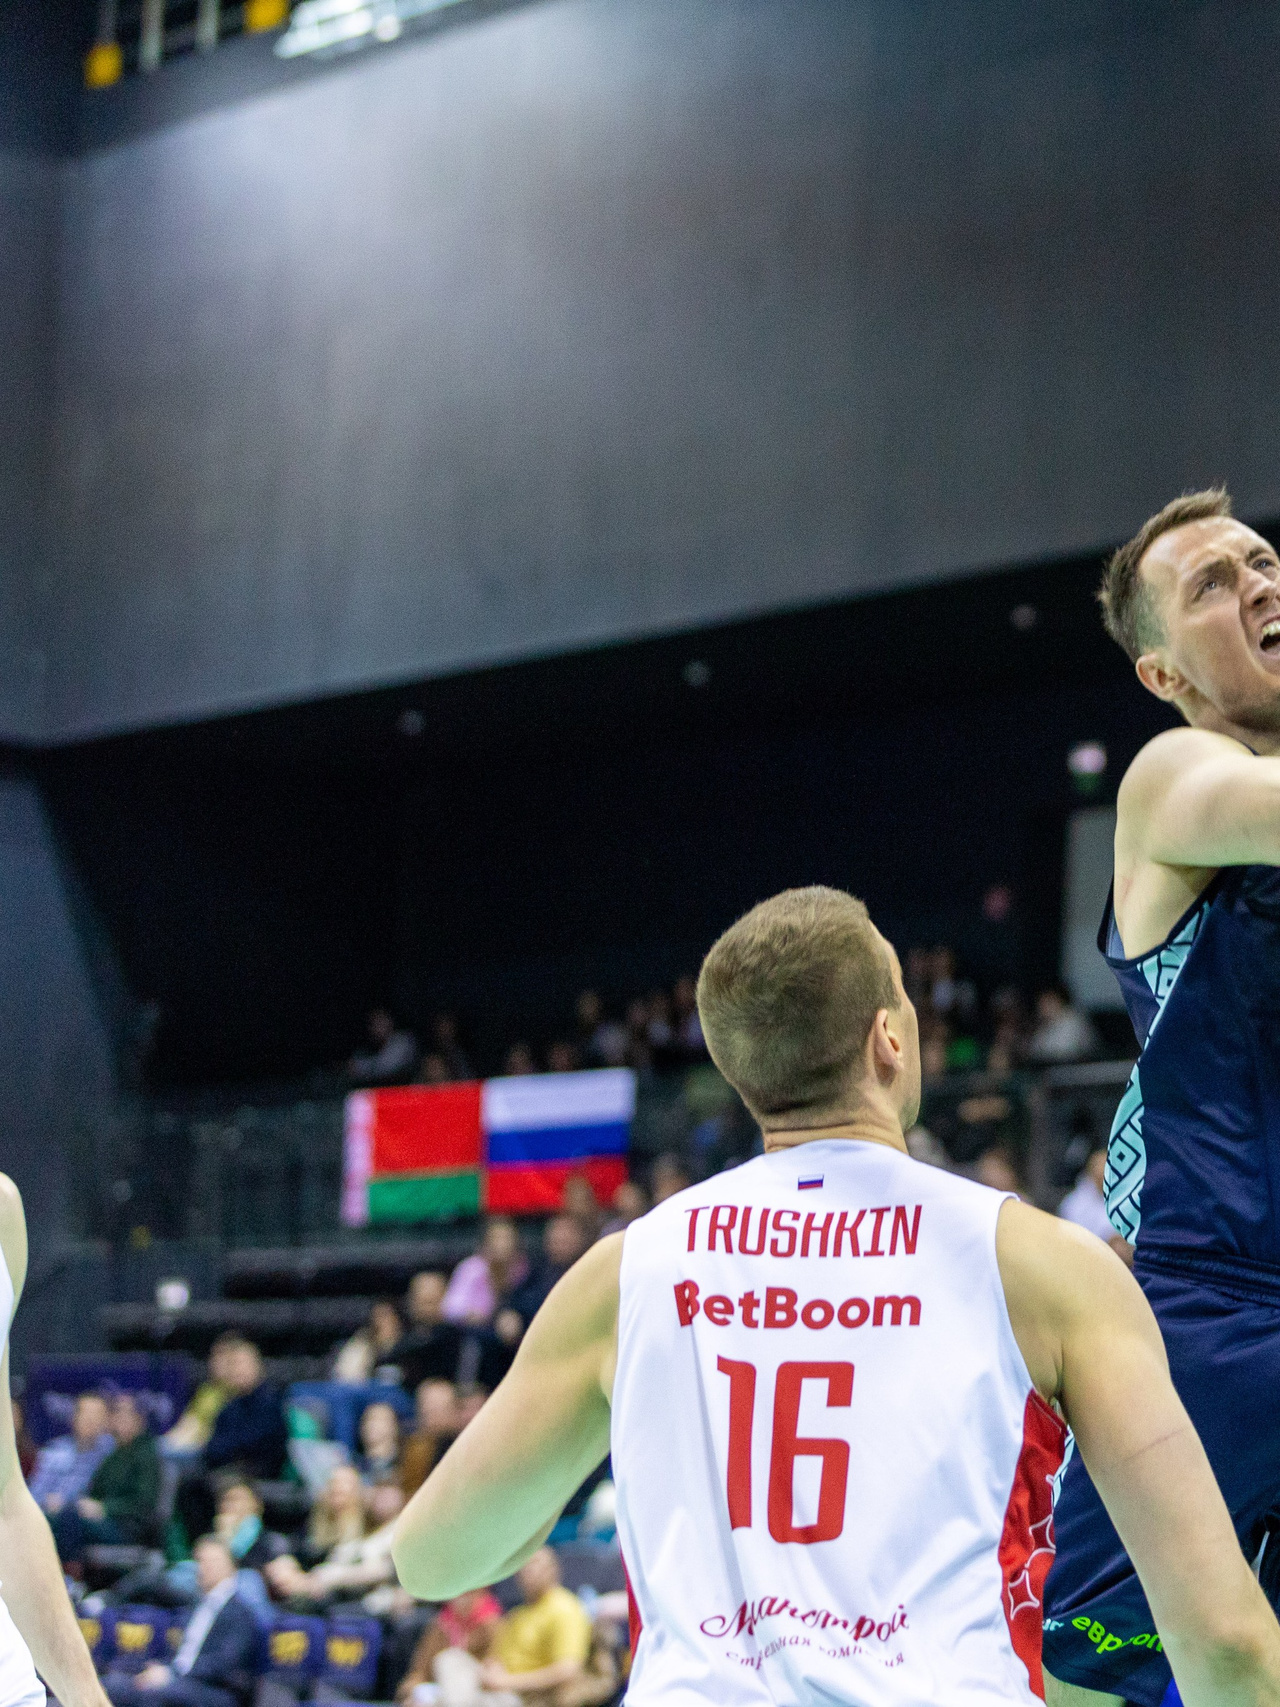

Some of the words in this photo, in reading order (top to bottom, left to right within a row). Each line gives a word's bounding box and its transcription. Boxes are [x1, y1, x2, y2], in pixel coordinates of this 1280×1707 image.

[685, 1204, 923, 1258] TRUSHKIN
[673, 1279, 922, 1330] BetBoom
[716, 1355, 855, 1545] 16
